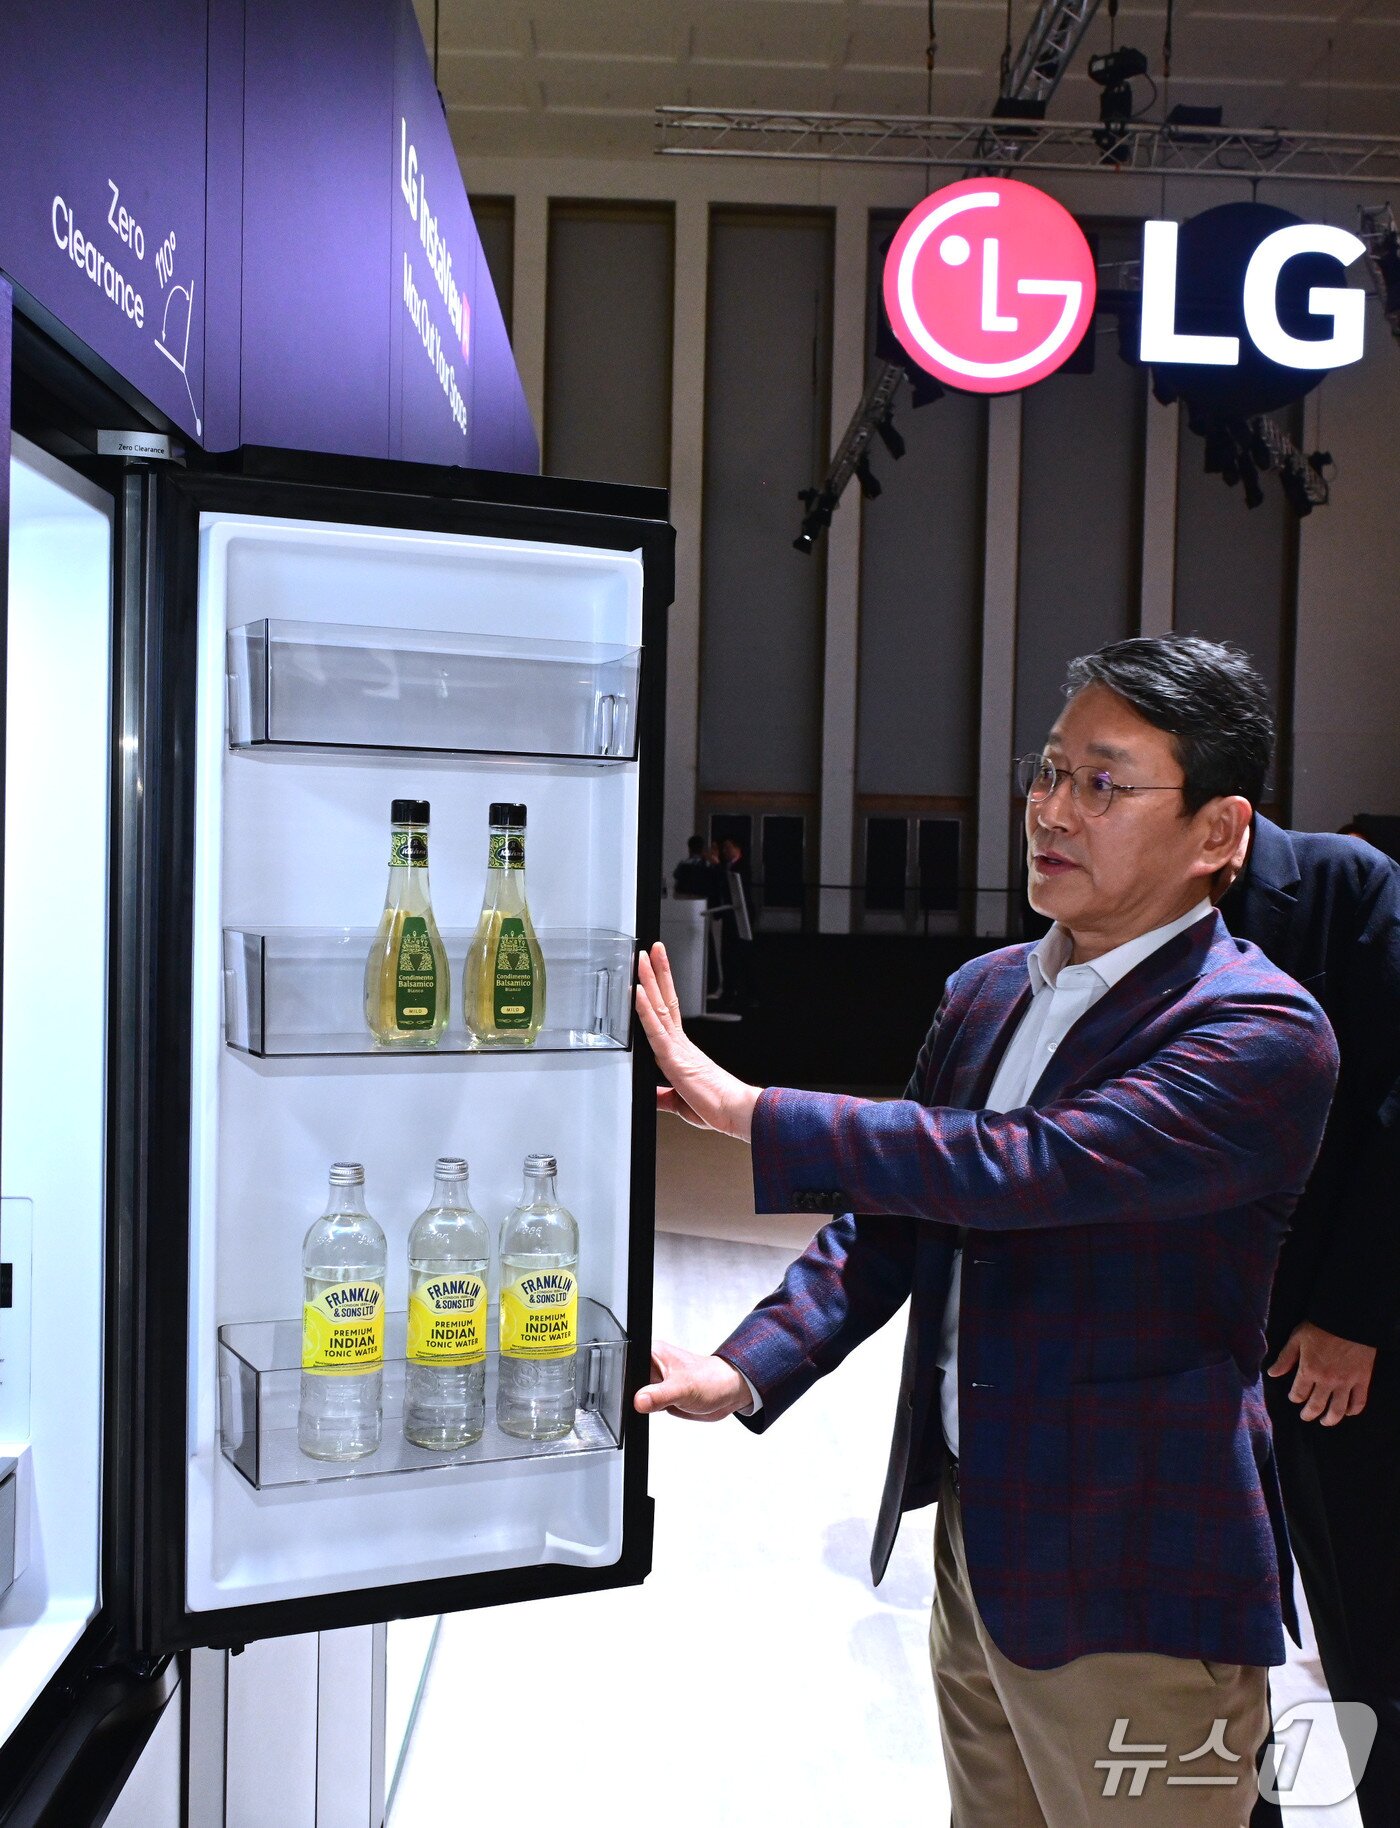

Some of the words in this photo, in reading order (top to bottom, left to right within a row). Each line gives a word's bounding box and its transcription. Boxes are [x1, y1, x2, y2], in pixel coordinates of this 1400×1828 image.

[401, 117, 418, 221] LG
[107, 178, 145, 260] Zero
[52, 196, 144, 328] Clearance
[1140, 220, 1367, 370] LG
[403, 252, 421, 334] Max
[421, 299, 435, 365] Out
[435, 327, 450, 396] Your
[450, 365, 467, 435] Space
[118, 443, 133, 451] Zero
[134, 445, 165, 454] Clearance
[426, 1280, 481, 1300] FRANKLIN
[521, 1275, 573, 1295] FRANKLIN
[324, 1287, 380, 1309] FRANKLIN
[435, 1300, 442, 1309] &
[442, 1299, 461, 1309] SONS
[462, 1298, 474, 1308] LTD
[529, 1294, 536, 1303] &
[536, 1293, 556, 1304] SONS
[555, 1292, 567, 1302] LTD
[333, 1308, 341, 1318] &
[341, 1308, 362, 1317] SONS
[362, 1305, 374, 1316] LTD
[529, 1313, 566, 1322] PREMIUM
[435, 1319, 473, 1328] PREMIUM
[525, 1320, 568, 1333] INDIAN
[334, 1327, 373, 1336] PREMIUM
[431, 1327, 476, 1340] INDIAN
[520, 1333, 546, 1341] TONIC
[549, 1330, 571, 1341] WATER
[329, 1335, 375, 1349] INDIAN
[426, 1340, 452, 1348] TONIC
[455, 1337, 479, 1348] WATER
[324, 1349, 352, 1357] TONIC
[354, 1346, 378, 1356] WATER
